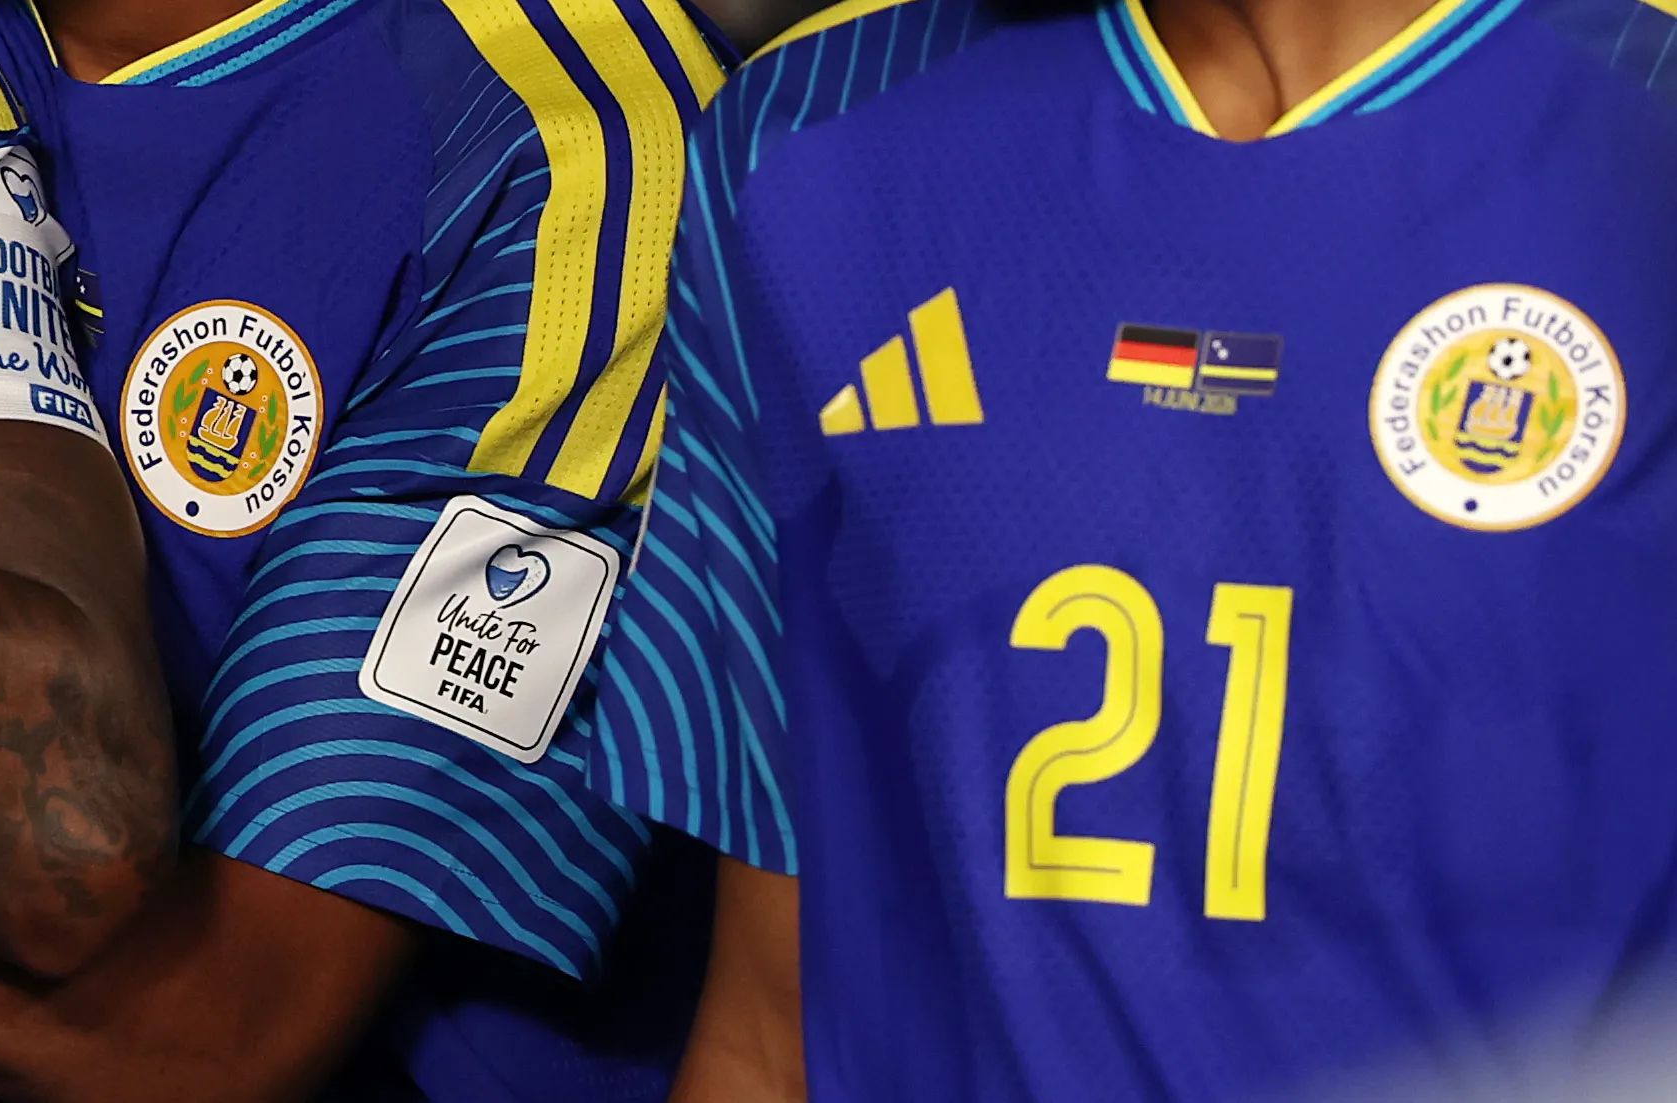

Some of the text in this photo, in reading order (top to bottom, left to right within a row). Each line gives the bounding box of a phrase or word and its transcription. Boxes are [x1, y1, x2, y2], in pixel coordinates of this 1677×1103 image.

[37, 391, 91, 424] FIFA
[131, 315, 311, 513] Federashon Futbòl Kòrsou
[1384, 297, 1611, 496] Federashon Futbòl Kòrsou
[436, 593, 541, 656] Unite For
[429, 632, 524, 698] PEACE
[437, 679, 485, 714] FIFA
[1004, 563, 1293, 922] 21
